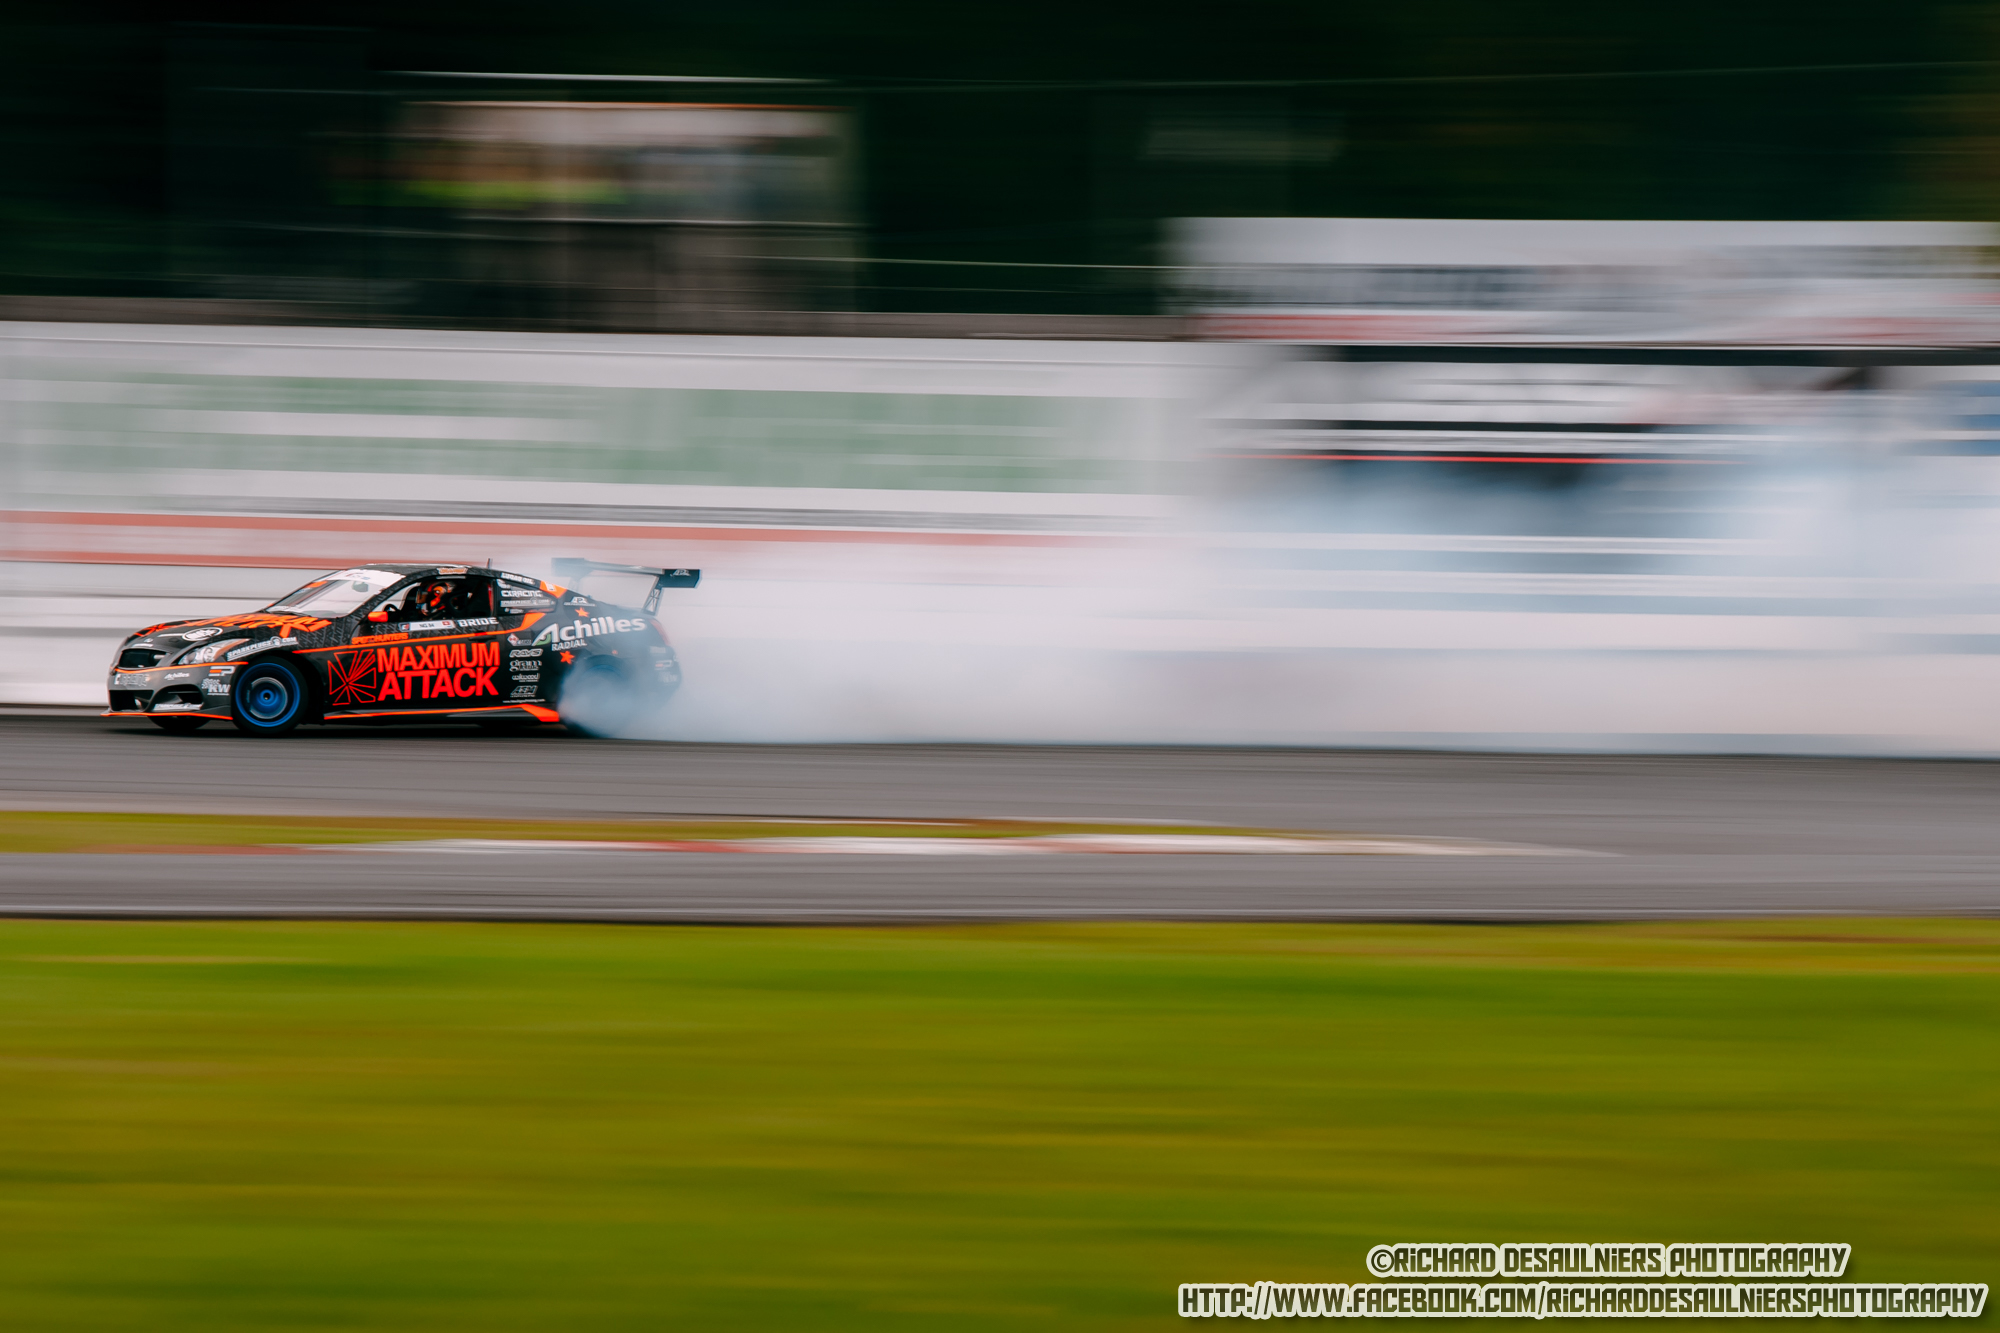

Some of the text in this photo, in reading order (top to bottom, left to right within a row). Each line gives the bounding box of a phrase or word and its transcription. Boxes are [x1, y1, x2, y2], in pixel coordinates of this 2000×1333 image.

[457, 617, 498, 627] BRIDE
[531, 616, 647, 646] Achilles
[376, 642, 500, 673] MAXIMUM
[552, 639, 587, 651] RADIAL
[377, 667, 499, 701] ATTACK
